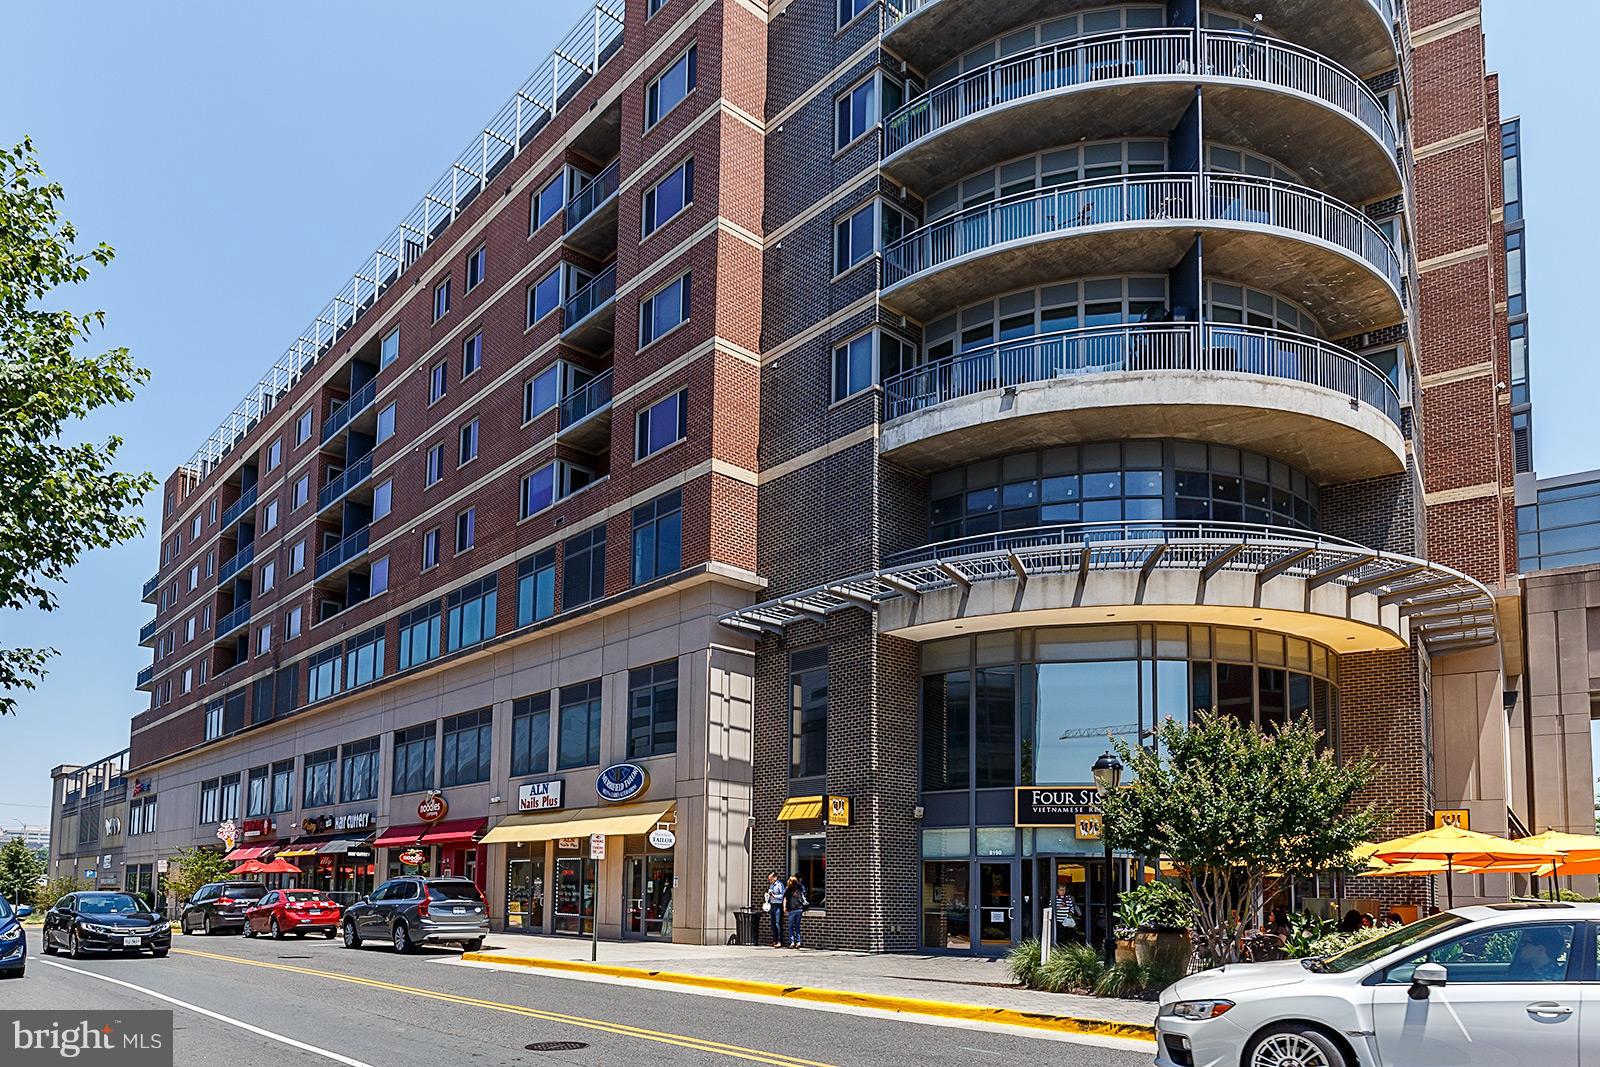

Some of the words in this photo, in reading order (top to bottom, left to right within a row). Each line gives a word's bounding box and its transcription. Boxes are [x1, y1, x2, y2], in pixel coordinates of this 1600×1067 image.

[530, 783, 550, 796] ALN
[520, 796, 539, 809] Nails
[542, 795, 558, 807] Plus
[1032, 790, 1077, 805] FOUR
[652, 836, 673, 844] TAILOR
